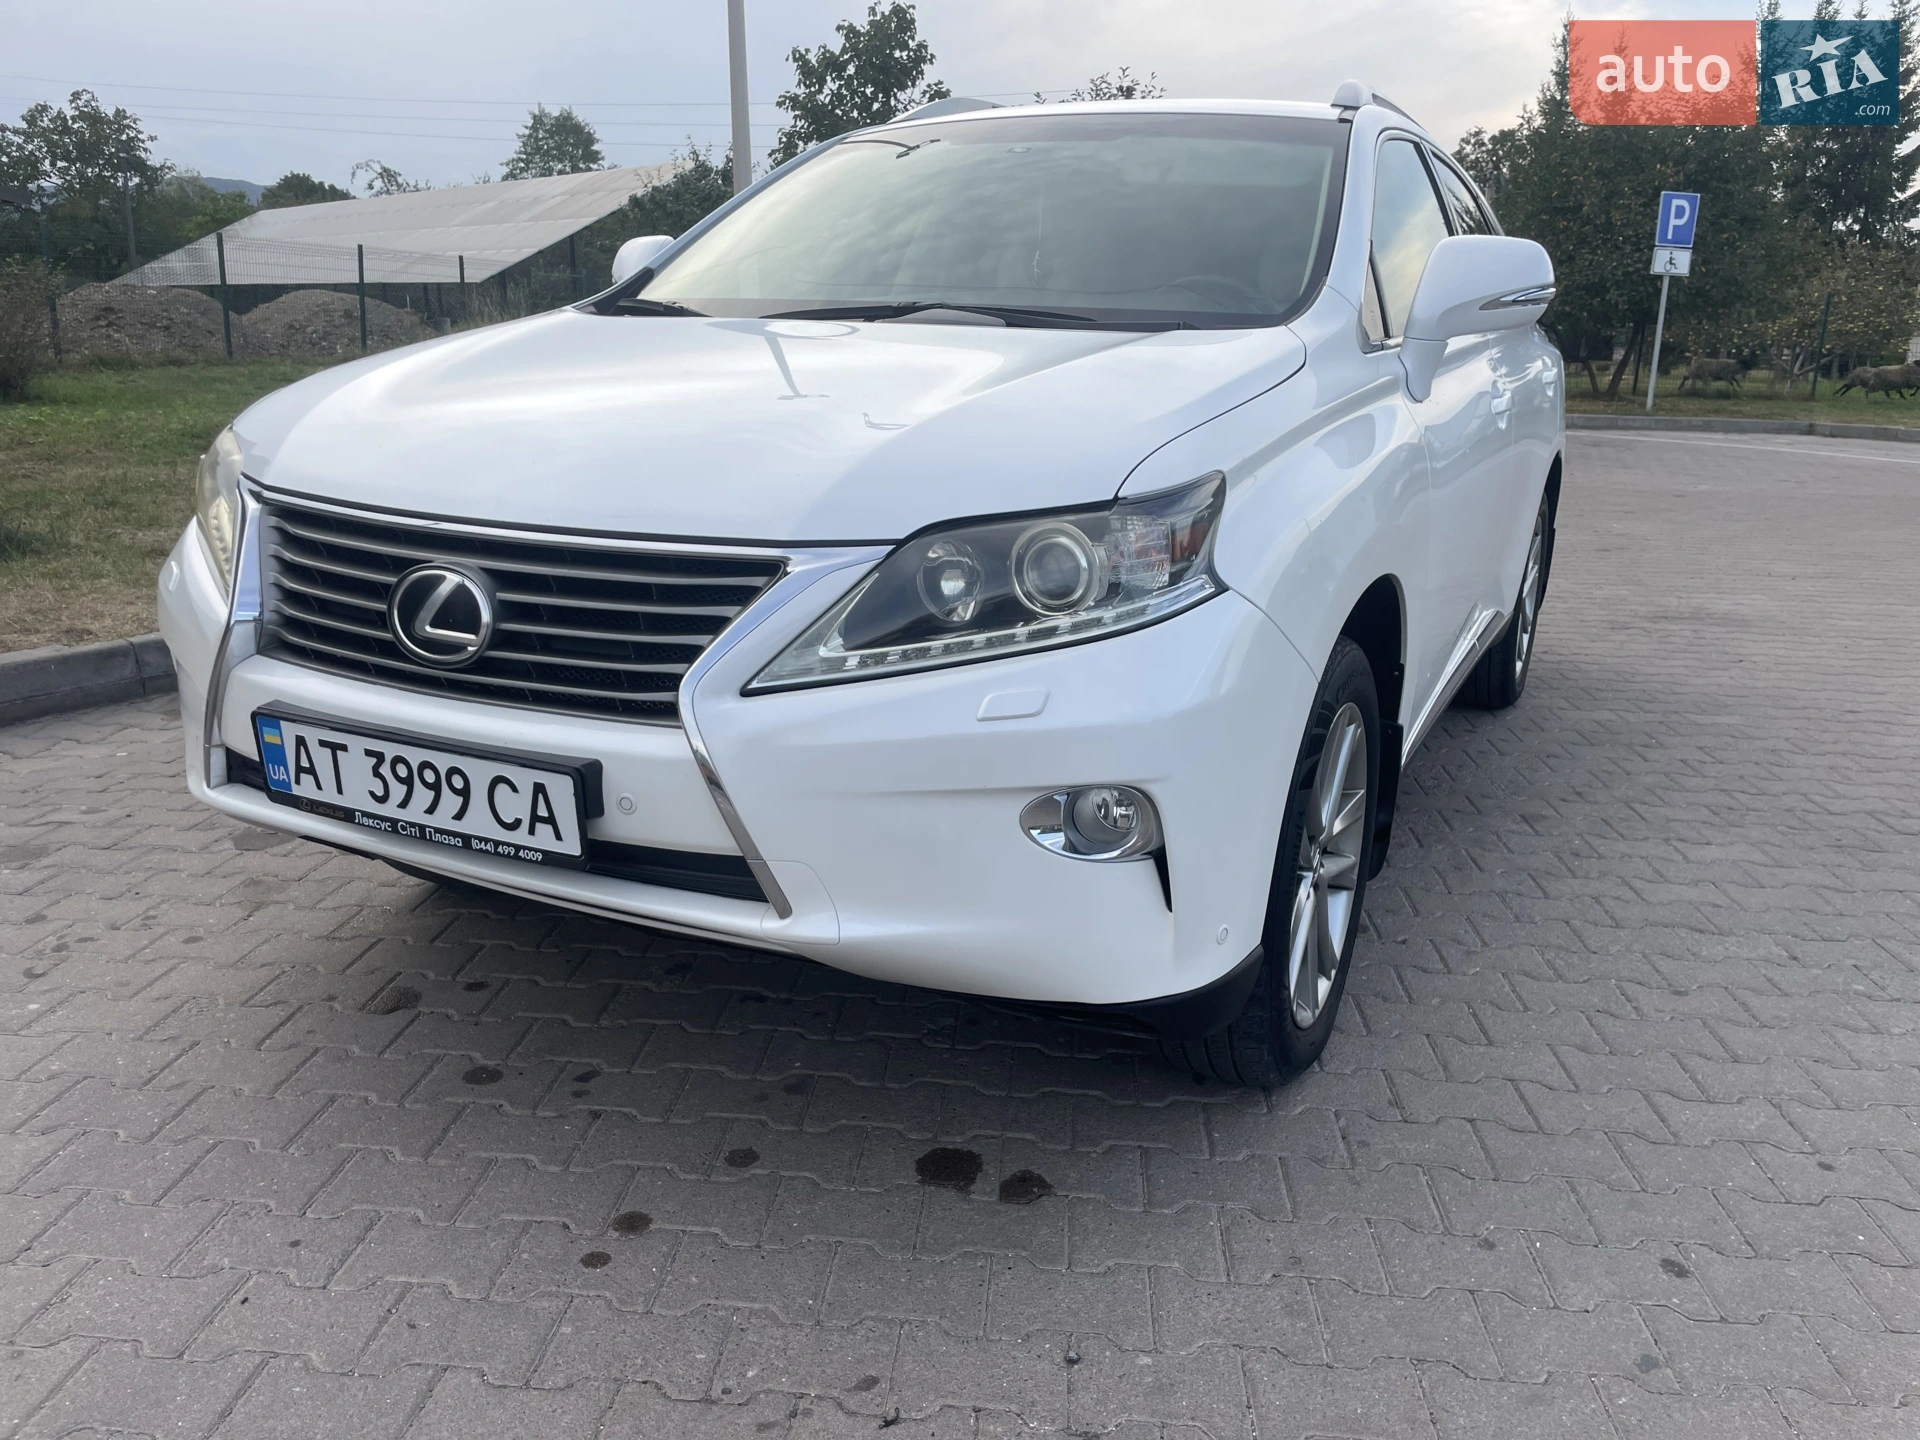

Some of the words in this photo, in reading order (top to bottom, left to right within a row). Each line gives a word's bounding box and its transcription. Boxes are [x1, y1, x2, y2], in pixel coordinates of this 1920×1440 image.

[1666, 198, 1691, 240] P
[268, 763, 289, 784] UA
[294, 733, 349, 796] AT
[363, 747, 472, 822] 3999
[486, 774, 564, 842] CA
[354, 811, 392, 831] Лексус
[397, 821, 420, 838] Сіті
[425, 827, 463, 847] Плаза
[471, 837, 495, 853] (044)
[497, 844, 516, 856] 499
[518, 848, 543, 862] 4009
